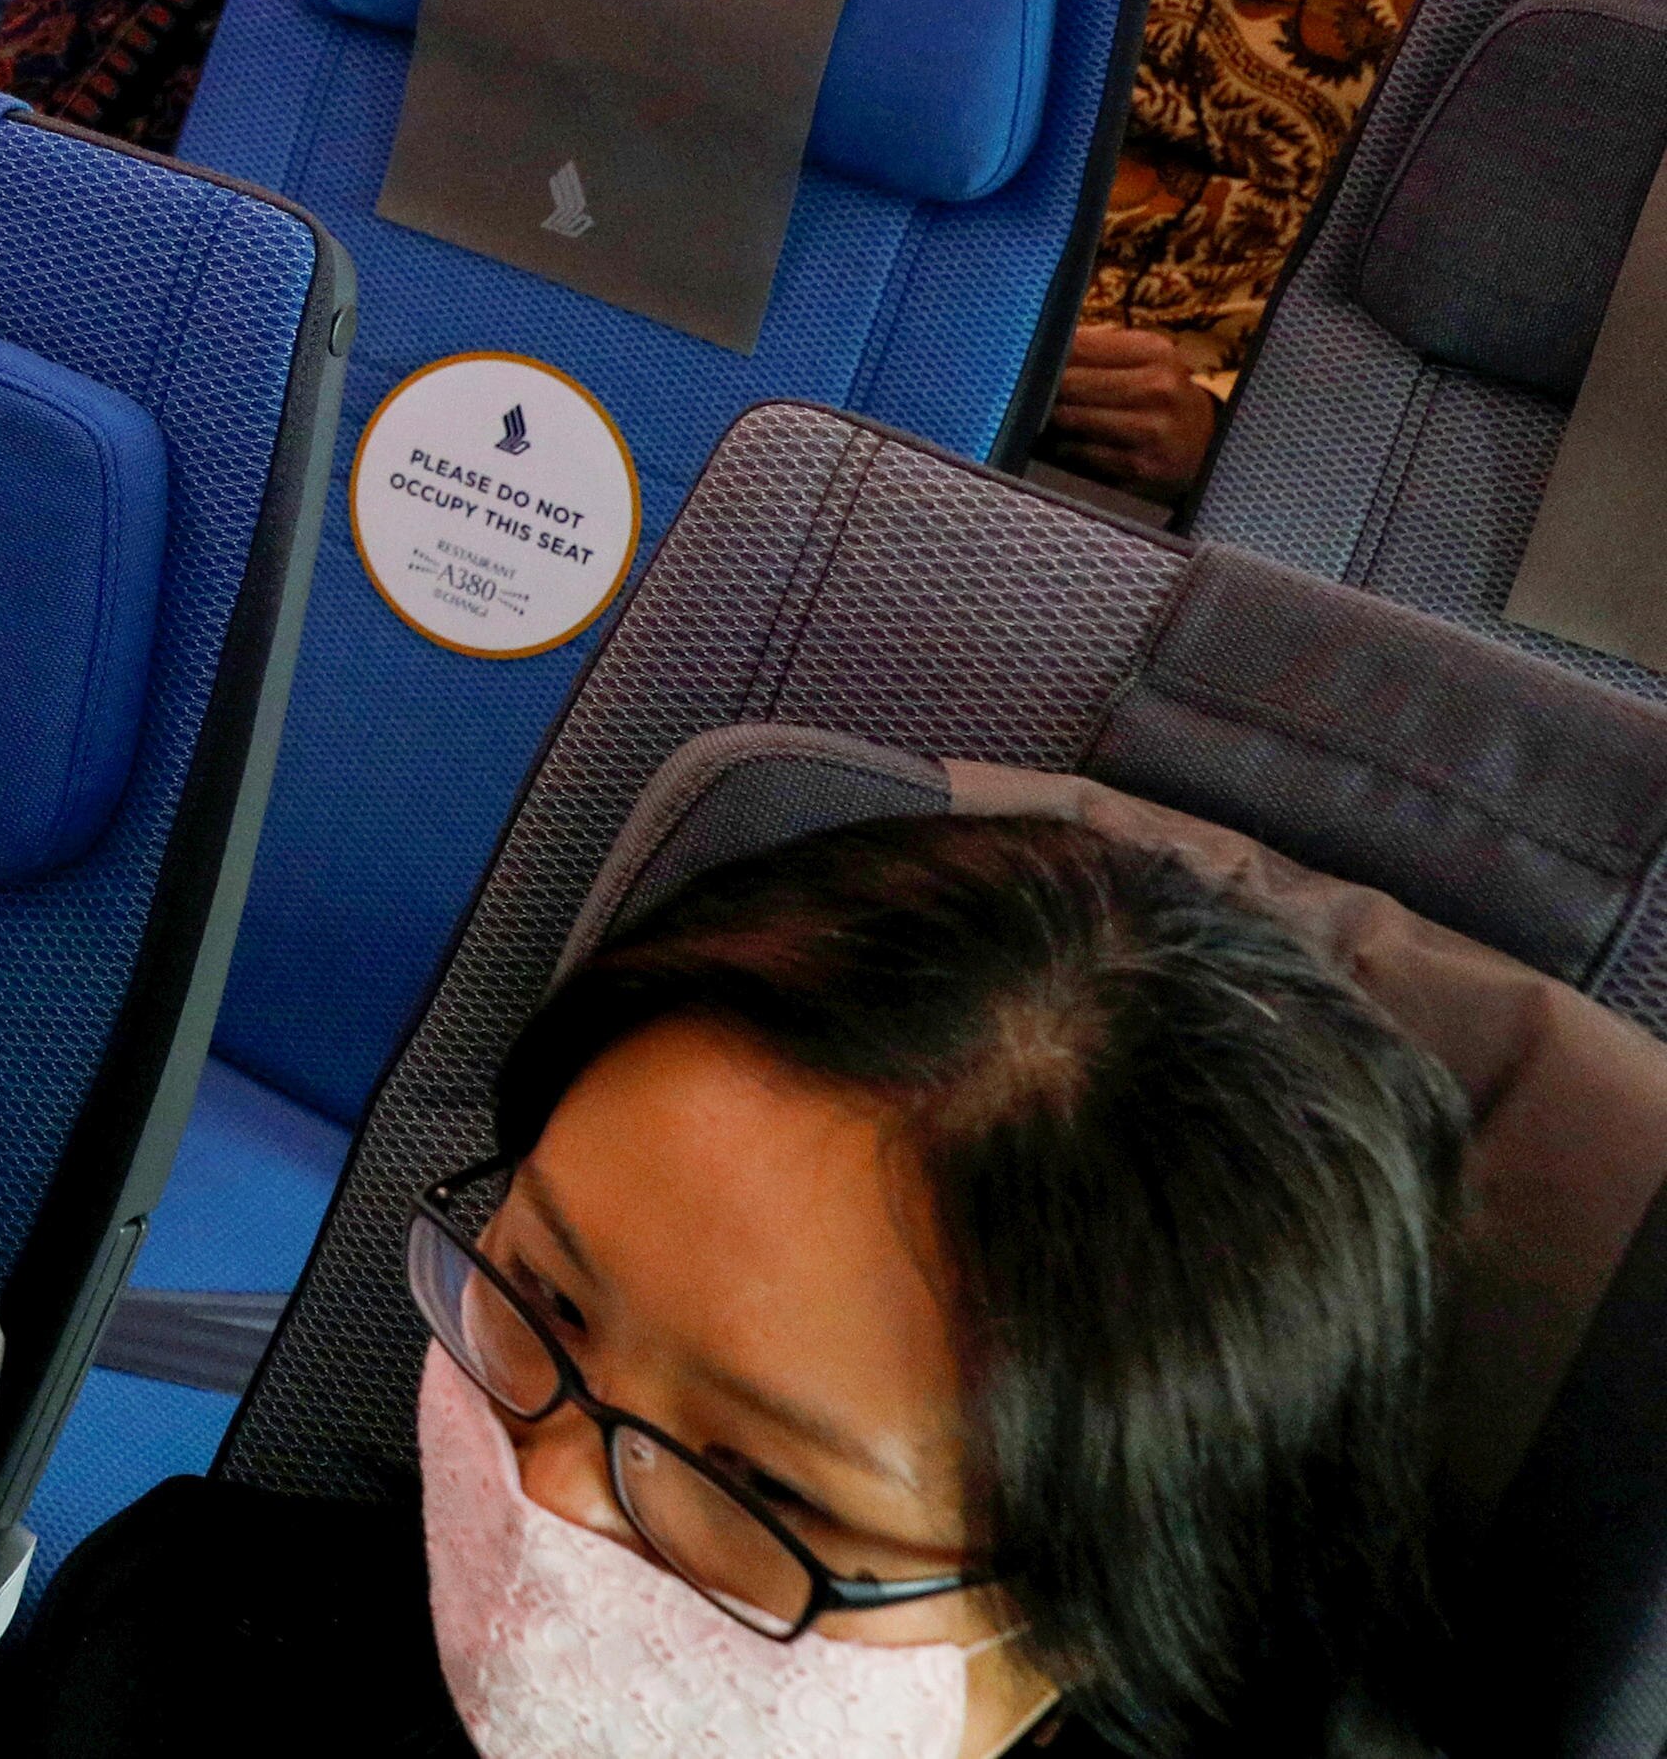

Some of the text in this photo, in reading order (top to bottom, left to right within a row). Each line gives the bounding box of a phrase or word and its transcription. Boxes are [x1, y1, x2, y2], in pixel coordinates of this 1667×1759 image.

[390, 473, 595, 566] OCCUPY THIS SEAT
[411, 448, 585, 531] PLEASE DO NOT
[437, 539, 517, 580] RESTAURANT
[437, 562, 497, 603] A380
